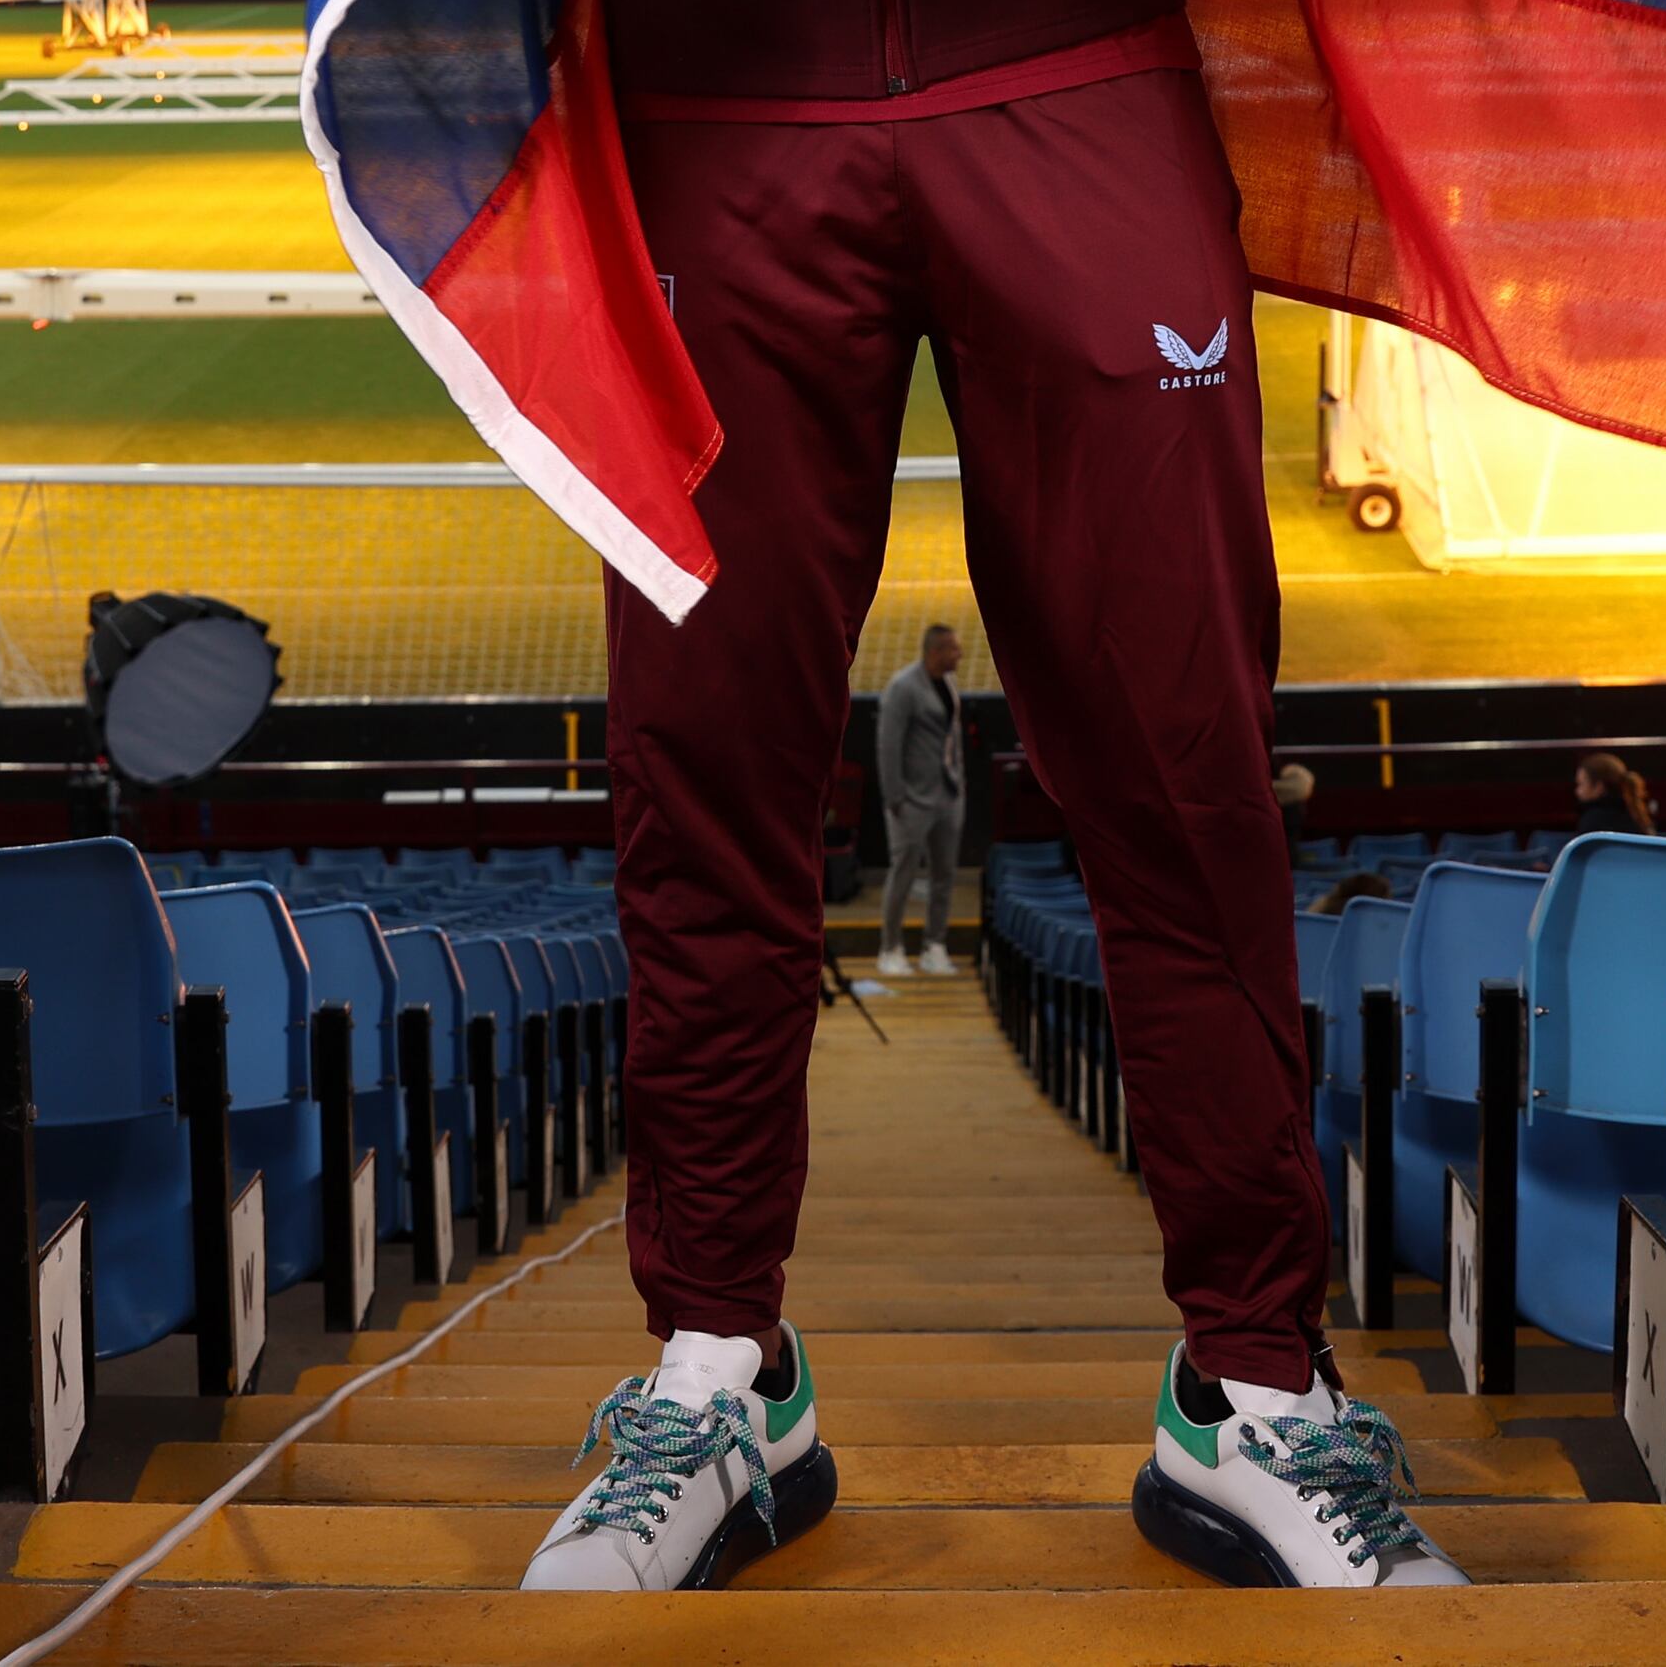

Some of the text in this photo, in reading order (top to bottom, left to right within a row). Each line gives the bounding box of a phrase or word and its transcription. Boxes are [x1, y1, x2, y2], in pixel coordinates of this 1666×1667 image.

[1159, 370, 1226, 390] CASTORE
[240, 1250, 255, 1321] W
[1457, 1243, 1471, 1326] W
[51, 1317, 67, 1406] X
[1642, 1308, 1656, 1398] X
